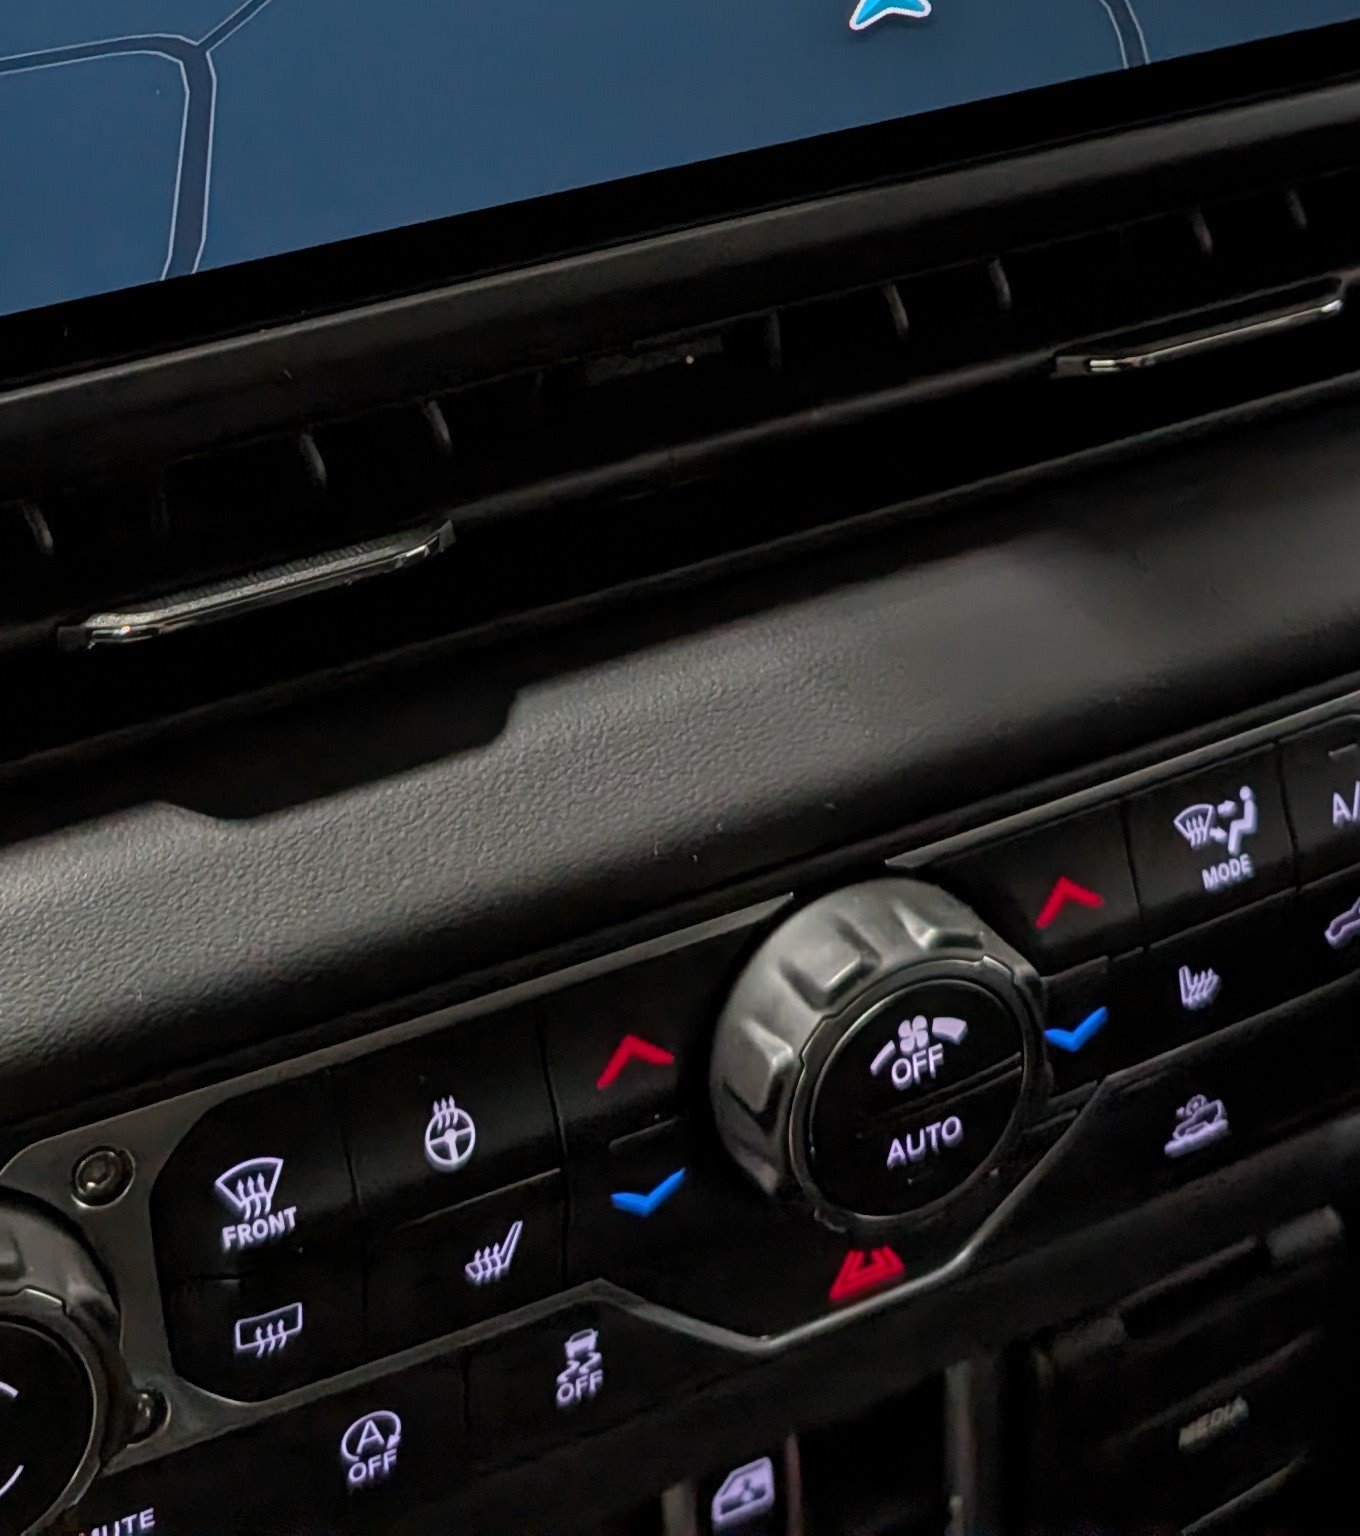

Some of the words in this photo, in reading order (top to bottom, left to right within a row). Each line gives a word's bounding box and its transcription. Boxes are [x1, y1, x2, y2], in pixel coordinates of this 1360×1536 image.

[1202, 853, 1253, 891] MODE
[891, 1043, 944, 1090] OFF
[887, 1115, 964, 1170] AUTO
[220, 1207, 298, 1252] FRONT
[556, 1368, 603, 1404] OFF
[348, 1449, 398, 1484] OFF
